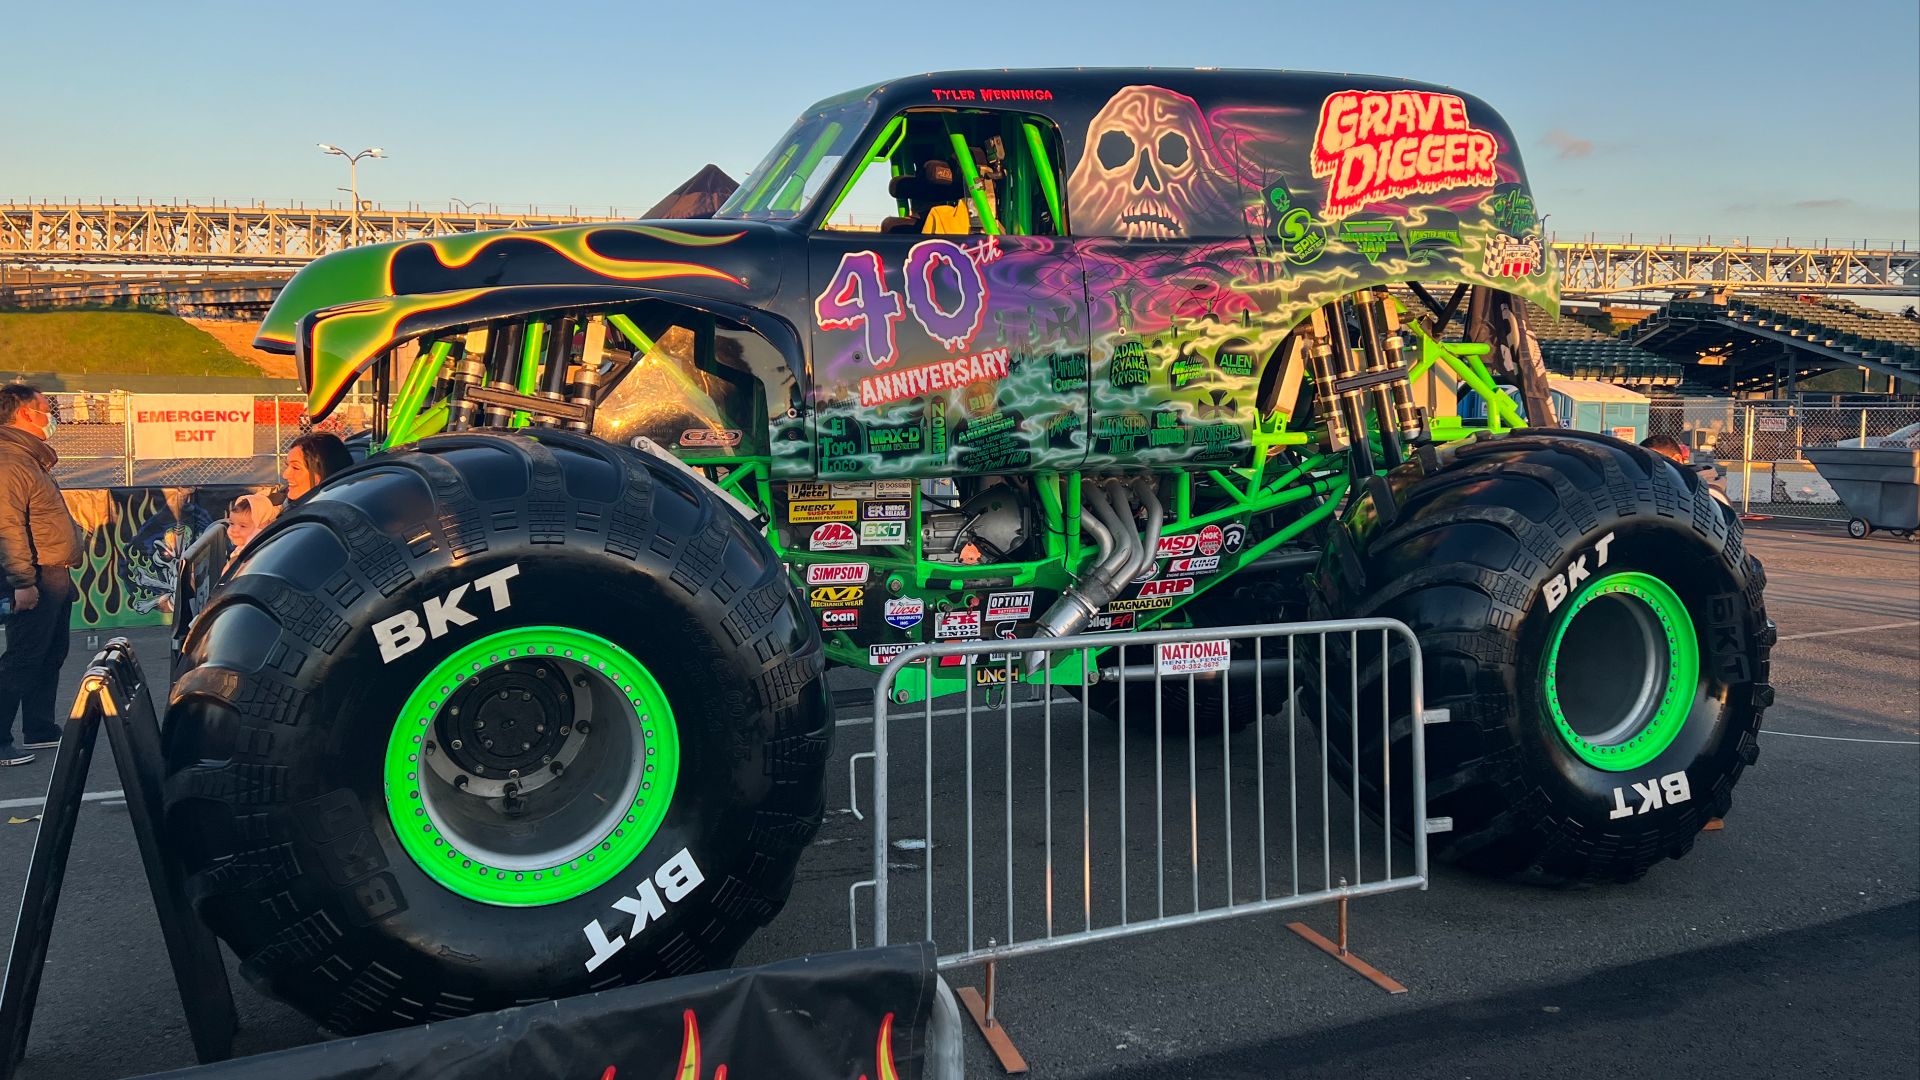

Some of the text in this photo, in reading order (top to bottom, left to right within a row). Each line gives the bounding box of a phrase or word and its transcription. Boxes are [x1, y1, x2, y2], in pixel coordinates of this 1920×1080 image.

[932, 88, 1053, 102] TYLER MENNINGA
[1321, 93, 1466, 155] GRAVE
[1334, 133, 1494, 201] DIGGER
[1293, 231, 1320, 253] SPIN
[1339, 232, 1400, 242] MONSTER
[1298, 237, 1325, 260] MASTER
[1357, 241, 1387, 253] JAM
[1114, 343, 1144, 360] ADAM
[1220, 354, 1252, 369] ALIEN
[861, 349, 1008, 405] ANNIVERSARY
[1053, 379, 1083, 392] Curse
[1111, 370, 1149, 388] KRYSTEN
[137, 410, 251, 423] EMERGENCY
[831, 418, 847, 436] El
[932, 402, 946, 467] ZOMBIE
[1100, 416, 1148, 436] MONSTER
[1194, 424, 1240, 443] MONSTER
[175, 430, 216, 442] EXIT
[869, 427, 920, 444] MAX-D
[820, 437, 855, 457] Toro
[822, 456, 857, 474] Loco
[794, 504, 835, 512] ENERGY
[814, 524, 853, 541] JAZ
[864, 523, 902, 537] BKT
[1158, 535, 1196, 551] MSD
[1190, 558, 1217, 568] KING
[812, 567, 863, 581] SIMPSON
[1542, 531, 1615, 613] BKT
[1140, 580, 1193, 596] ARP
[811, 599, 863, 608] MECHANIX WEAR
[992, 596, 1029, 607] OPTIMA
[1110, 599, 1172, 610] MAGNAFLOW
[371, 563, 520, 664] BKT
[823, 611, 855, 623] Coan
[890, 606, 920, 615] LUCAS
[1162, 641, 1228, 660] NATIONAL
[1610, 770, 1691, 820] BKT
[583, 846, 705, 973] BKT
